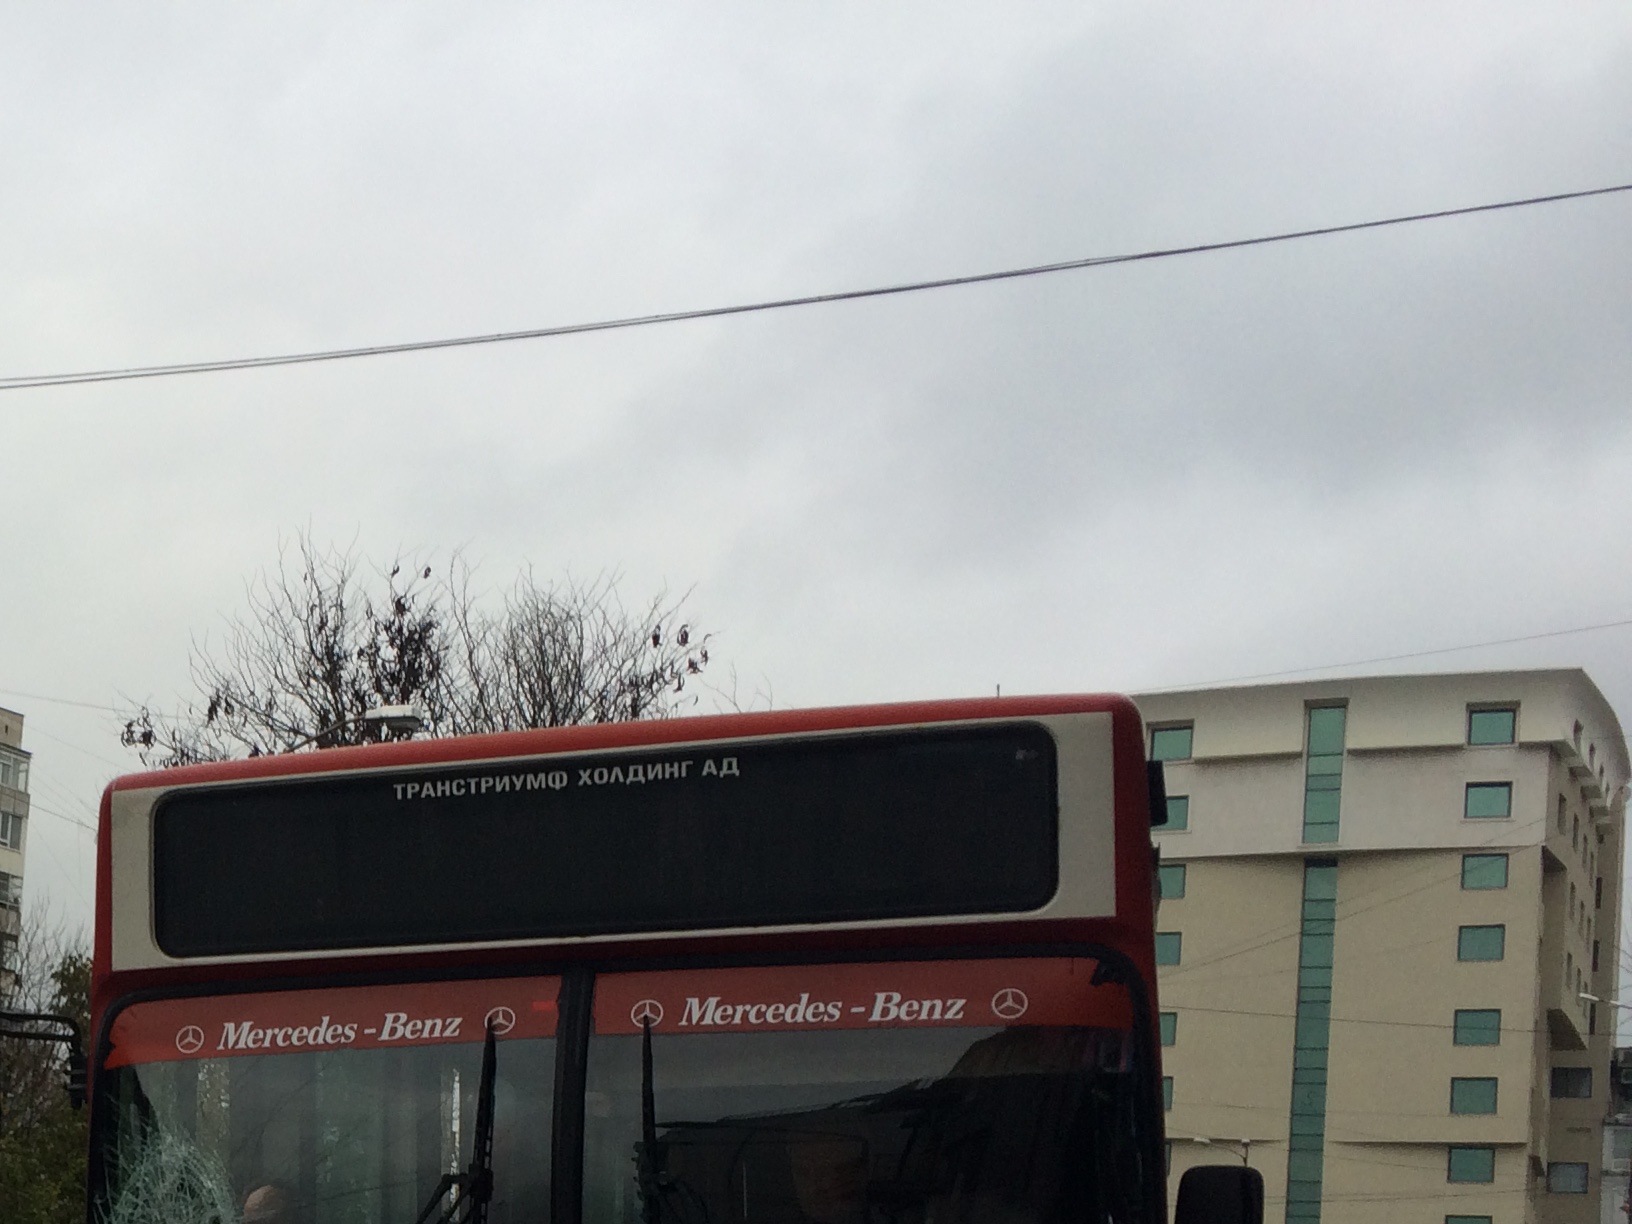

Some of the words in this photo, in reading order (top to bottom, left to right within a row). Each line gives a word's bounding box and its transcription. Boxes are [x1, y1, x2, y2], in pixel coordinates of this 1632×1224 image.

[393, 769, 569, 801] ТРАНСТРИУМФ
[577, 760, 694, 787] ХОЛДИНГ
[701, 757, 741, 778] АД
